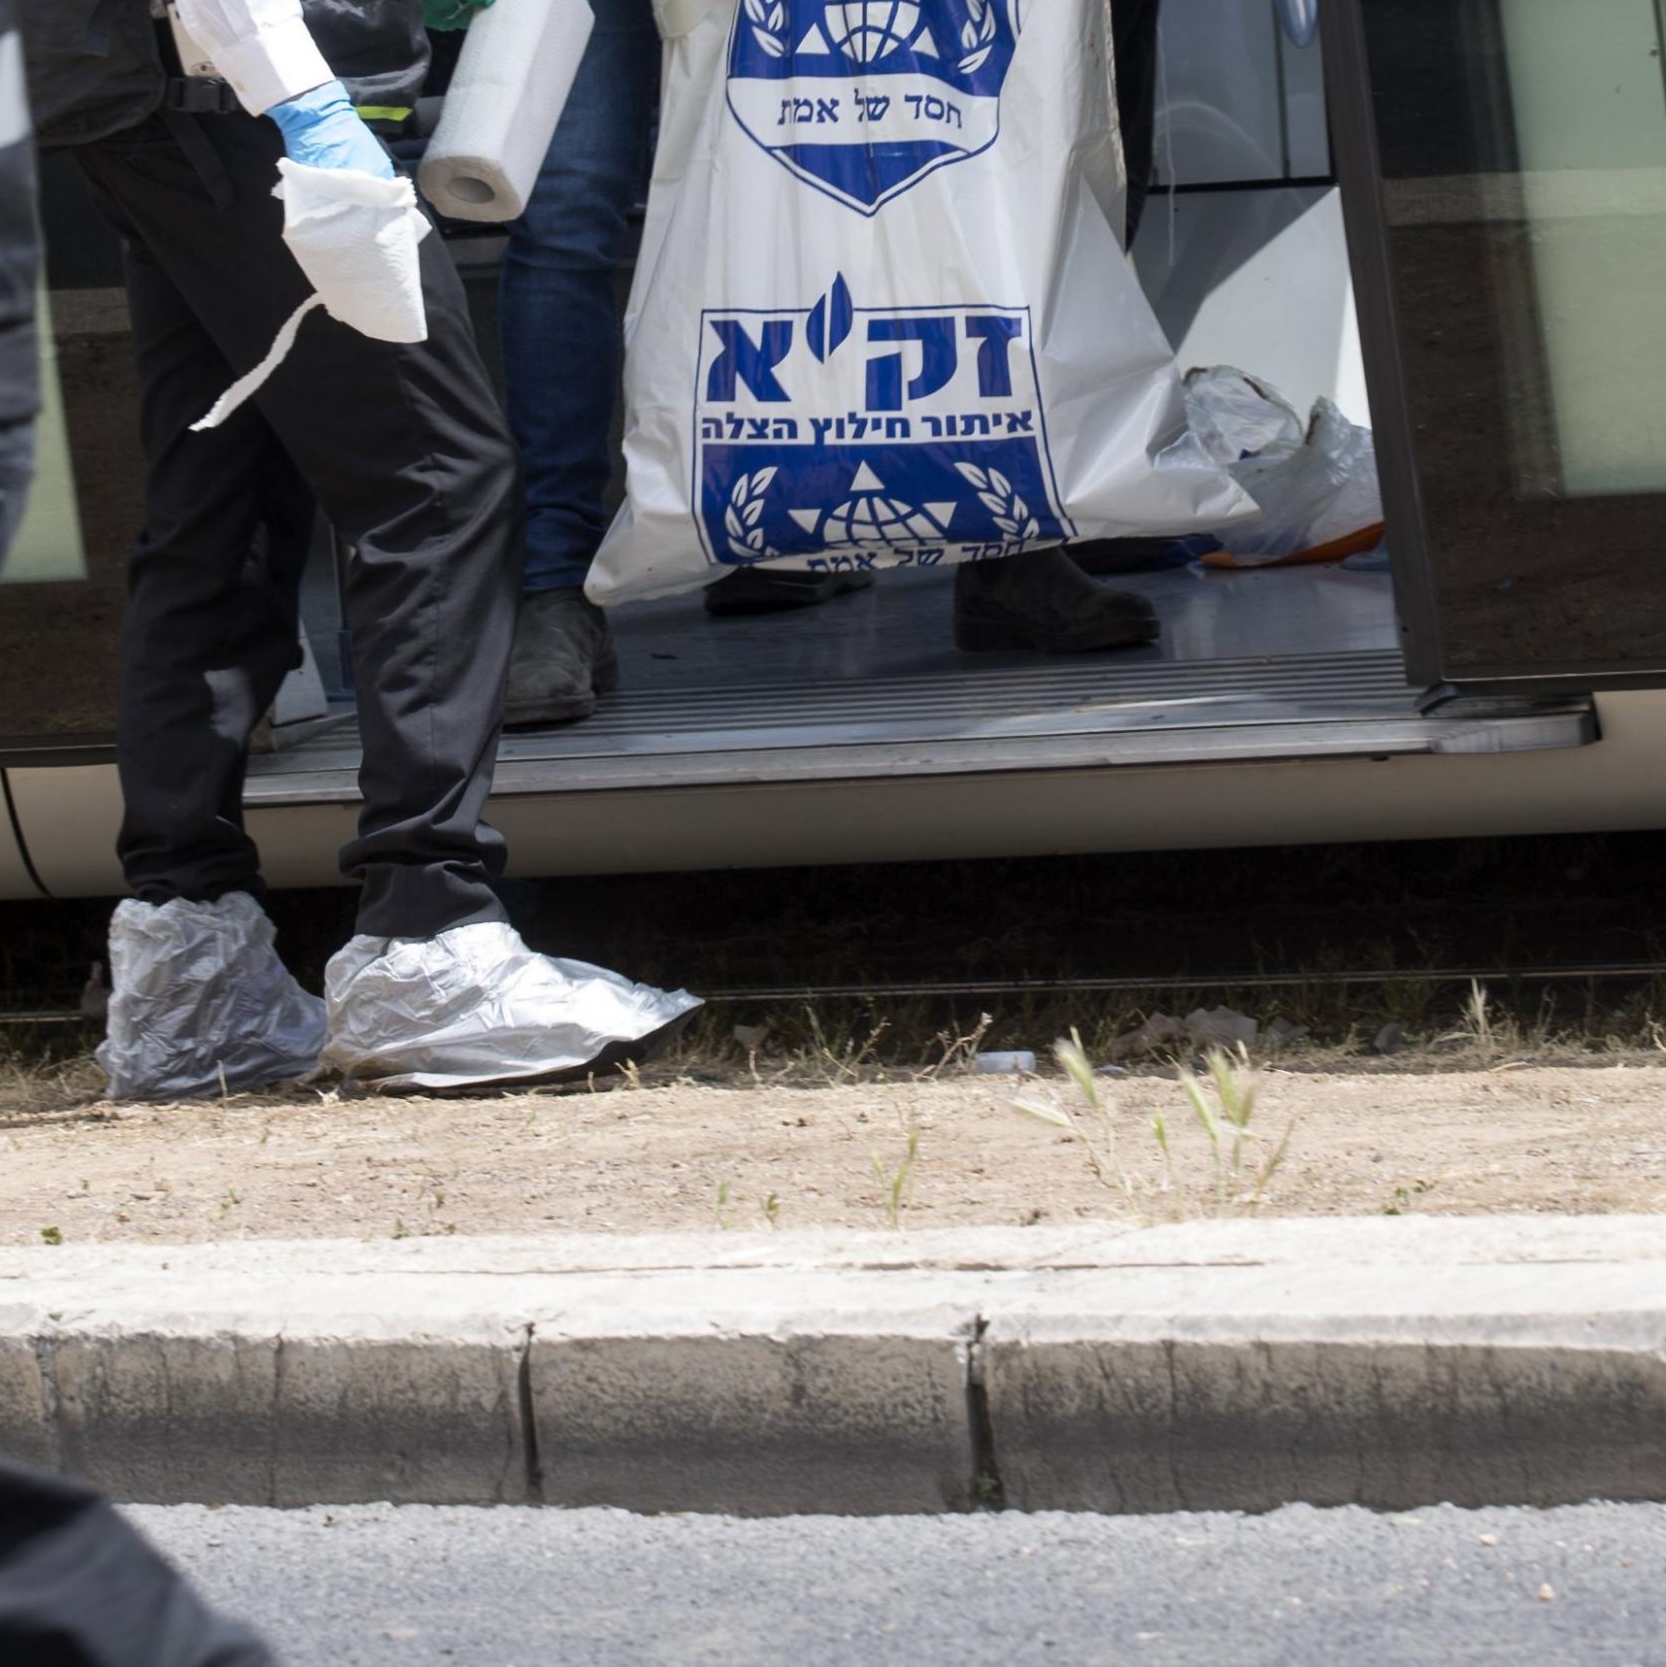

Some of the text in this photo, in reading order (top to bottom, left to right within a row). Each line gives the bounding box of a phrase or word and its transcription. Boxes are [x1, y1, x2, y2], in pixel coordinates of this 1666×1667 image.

[777, 88, 962, 129] חסד של אמת
[701, 410, 1036, 443] איתור חילוץ הצלה
[894, 546, 945, 566] של
